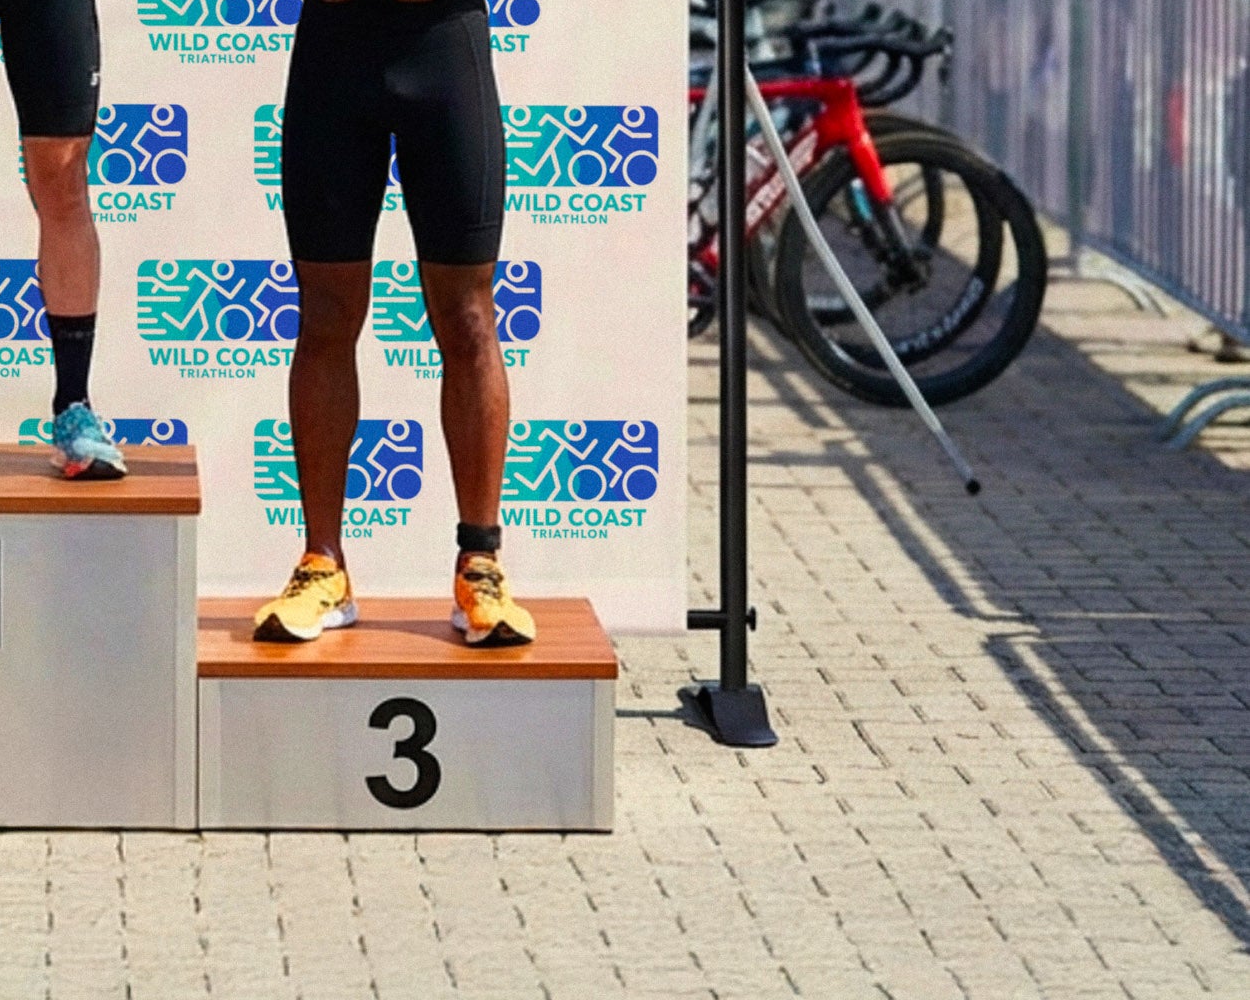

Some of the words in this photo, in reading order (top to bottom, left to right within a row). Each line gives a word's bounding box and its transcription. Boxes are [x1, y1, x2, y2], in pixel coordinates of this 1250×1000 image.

[148, 33, 209, 51] WILD
[215, 33, 295, 52] COAST
[489, 34, 530, 52] AST
[179, 54, 255, 64] TRIATHLON
[96, 192, 176, 210] COAST
[503, 194, 561, 211] WILD
[567, 193, 646, 212] COAST
[93, 213, 137, 222] THLON
[532, 214, 607, 224] TRIATHLON
[148, 348, 209, 366] WILD
[215, 348, 294, 366] COAST
[383, 349, 443, 366] WILD
[180, 369, 255, 378] TRIATHLON
[264, 508, 305, 525] WIL
[341, 507, 411, 526] OAST
[500, 508, 561, 526] WILD
[567, 508, 646, 526] COAST
[532, 529, 607, 538] TRIATHLON
[366, 698, 442, 809] 3
